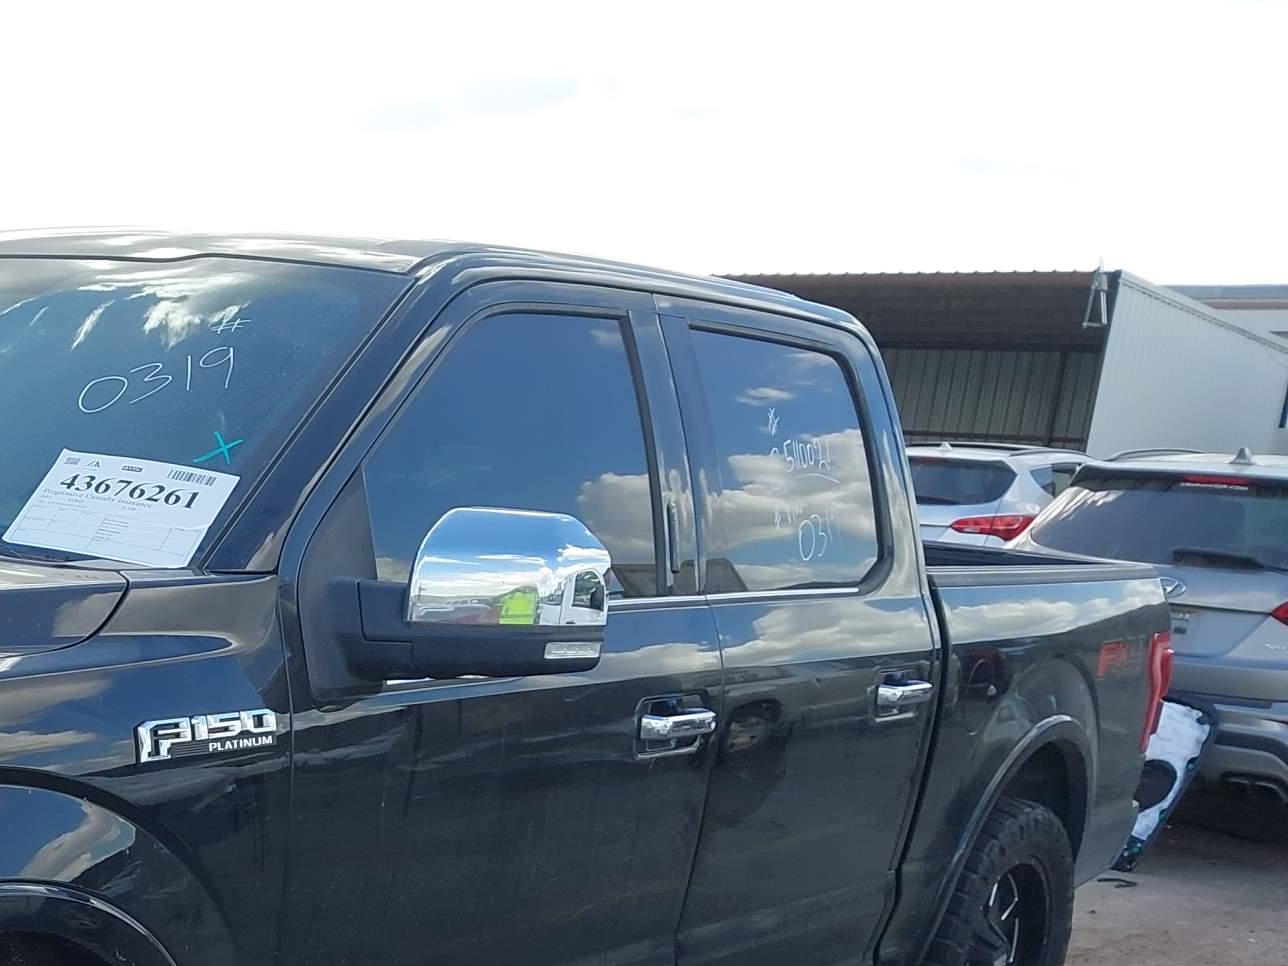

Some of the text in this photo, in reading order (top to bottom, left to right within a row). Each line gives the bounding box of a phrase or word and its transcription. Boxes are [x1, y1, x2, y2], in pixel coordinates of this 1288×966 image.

[78, 347, 235, 413] 0319
[60, 473, 200, 510] 43676261
[208, 735, 273, 752] PLATINUM
